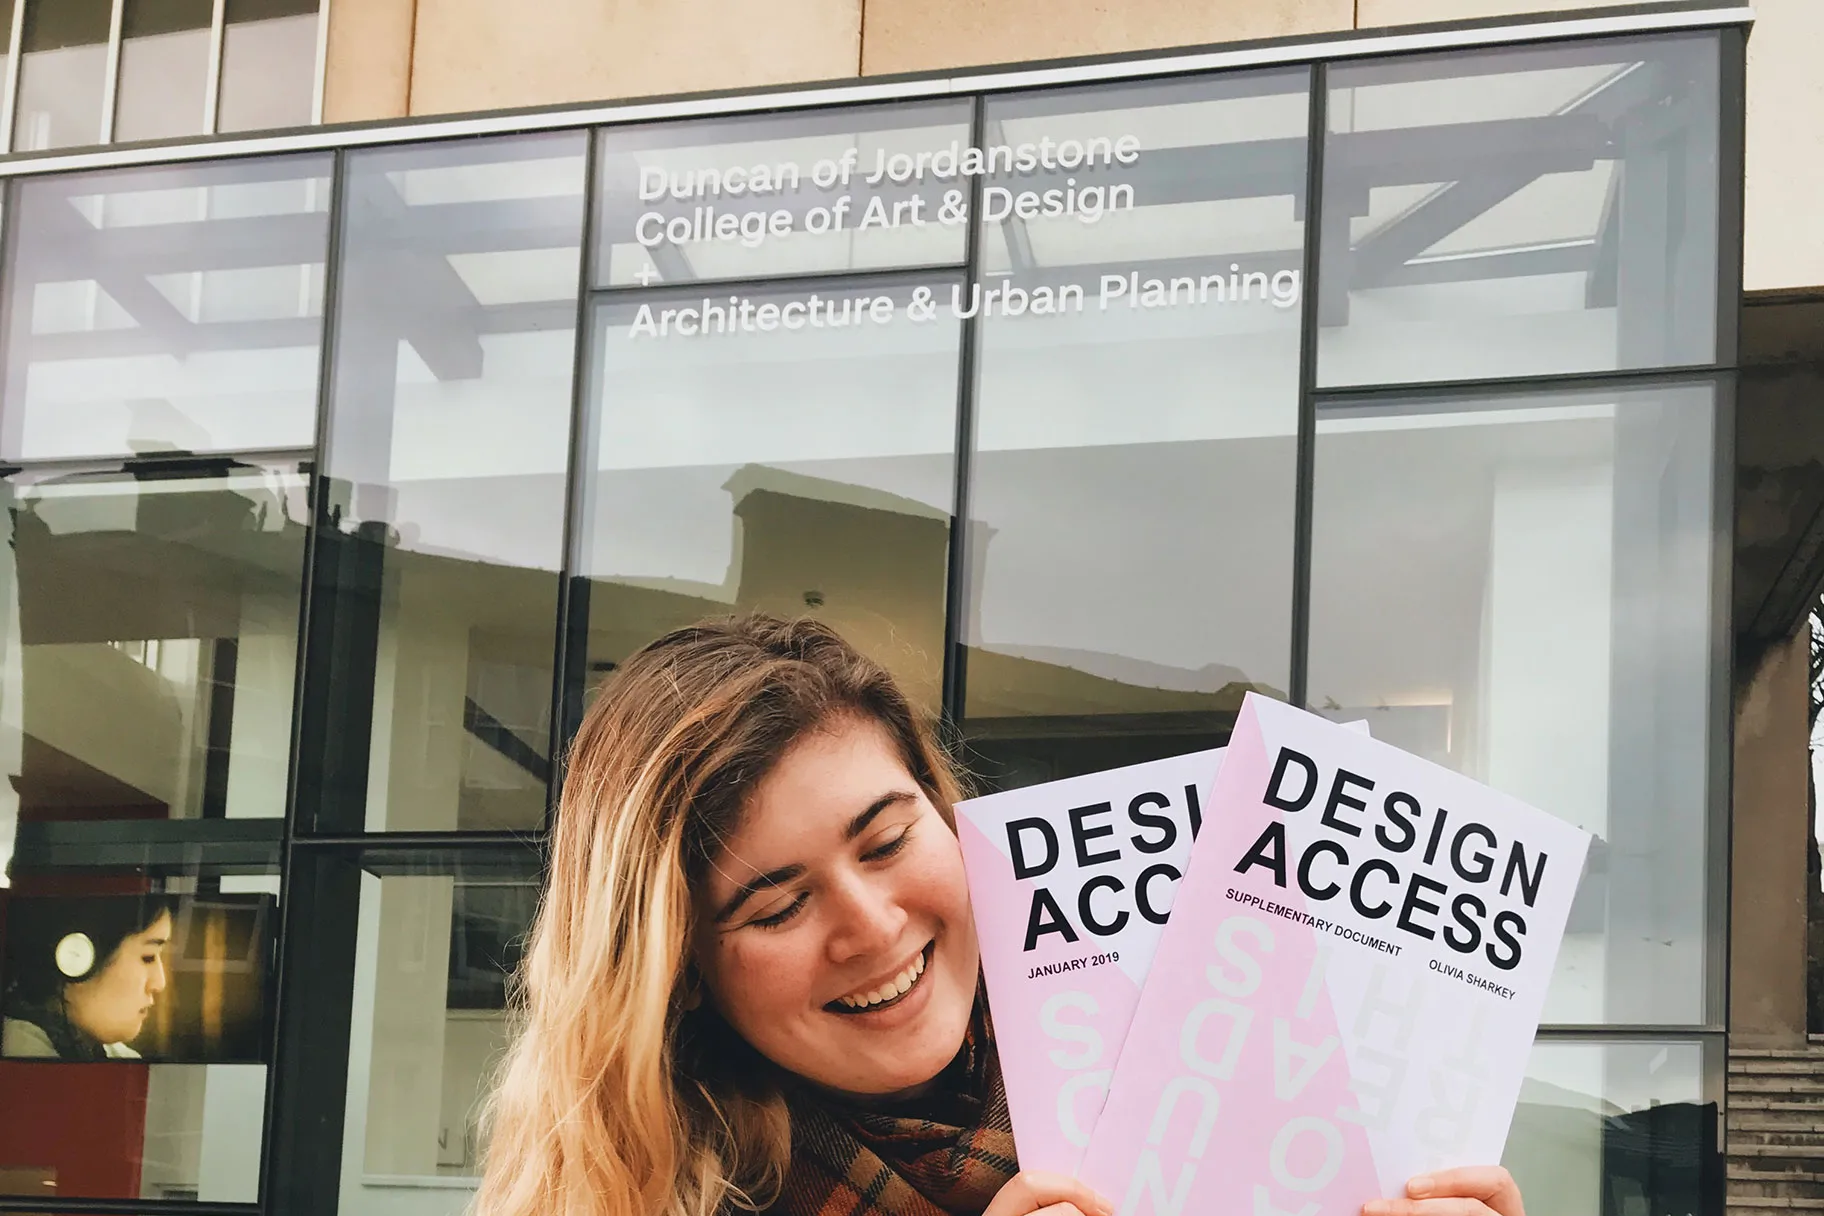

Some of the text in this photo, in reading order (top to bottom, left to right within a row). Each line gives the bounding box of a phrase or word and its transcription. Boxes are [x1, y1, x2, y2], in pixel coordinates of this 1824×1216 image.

[638, 133, 1142, 200] Duncan of Jordanstone
[635, 177, 1135, 248] College of Art & Design
[629, 263, 1301, 338] Architecture & Urban Planning
[1005, 783, 1203, 881] DESI
[1262, 746, 1548, 908] DESIGN
[1023, 863, 1183, 952] ACC
[1225, 888, 1402, 957] SUPPLEMENTARY DOCUMENT
[1232, 820, 1527, 971] ACCESS
[1027, 951, 1120, 979] JANUARY 2019
[1429, 959, 1516, 1000] OLIVIA SHARKEY
